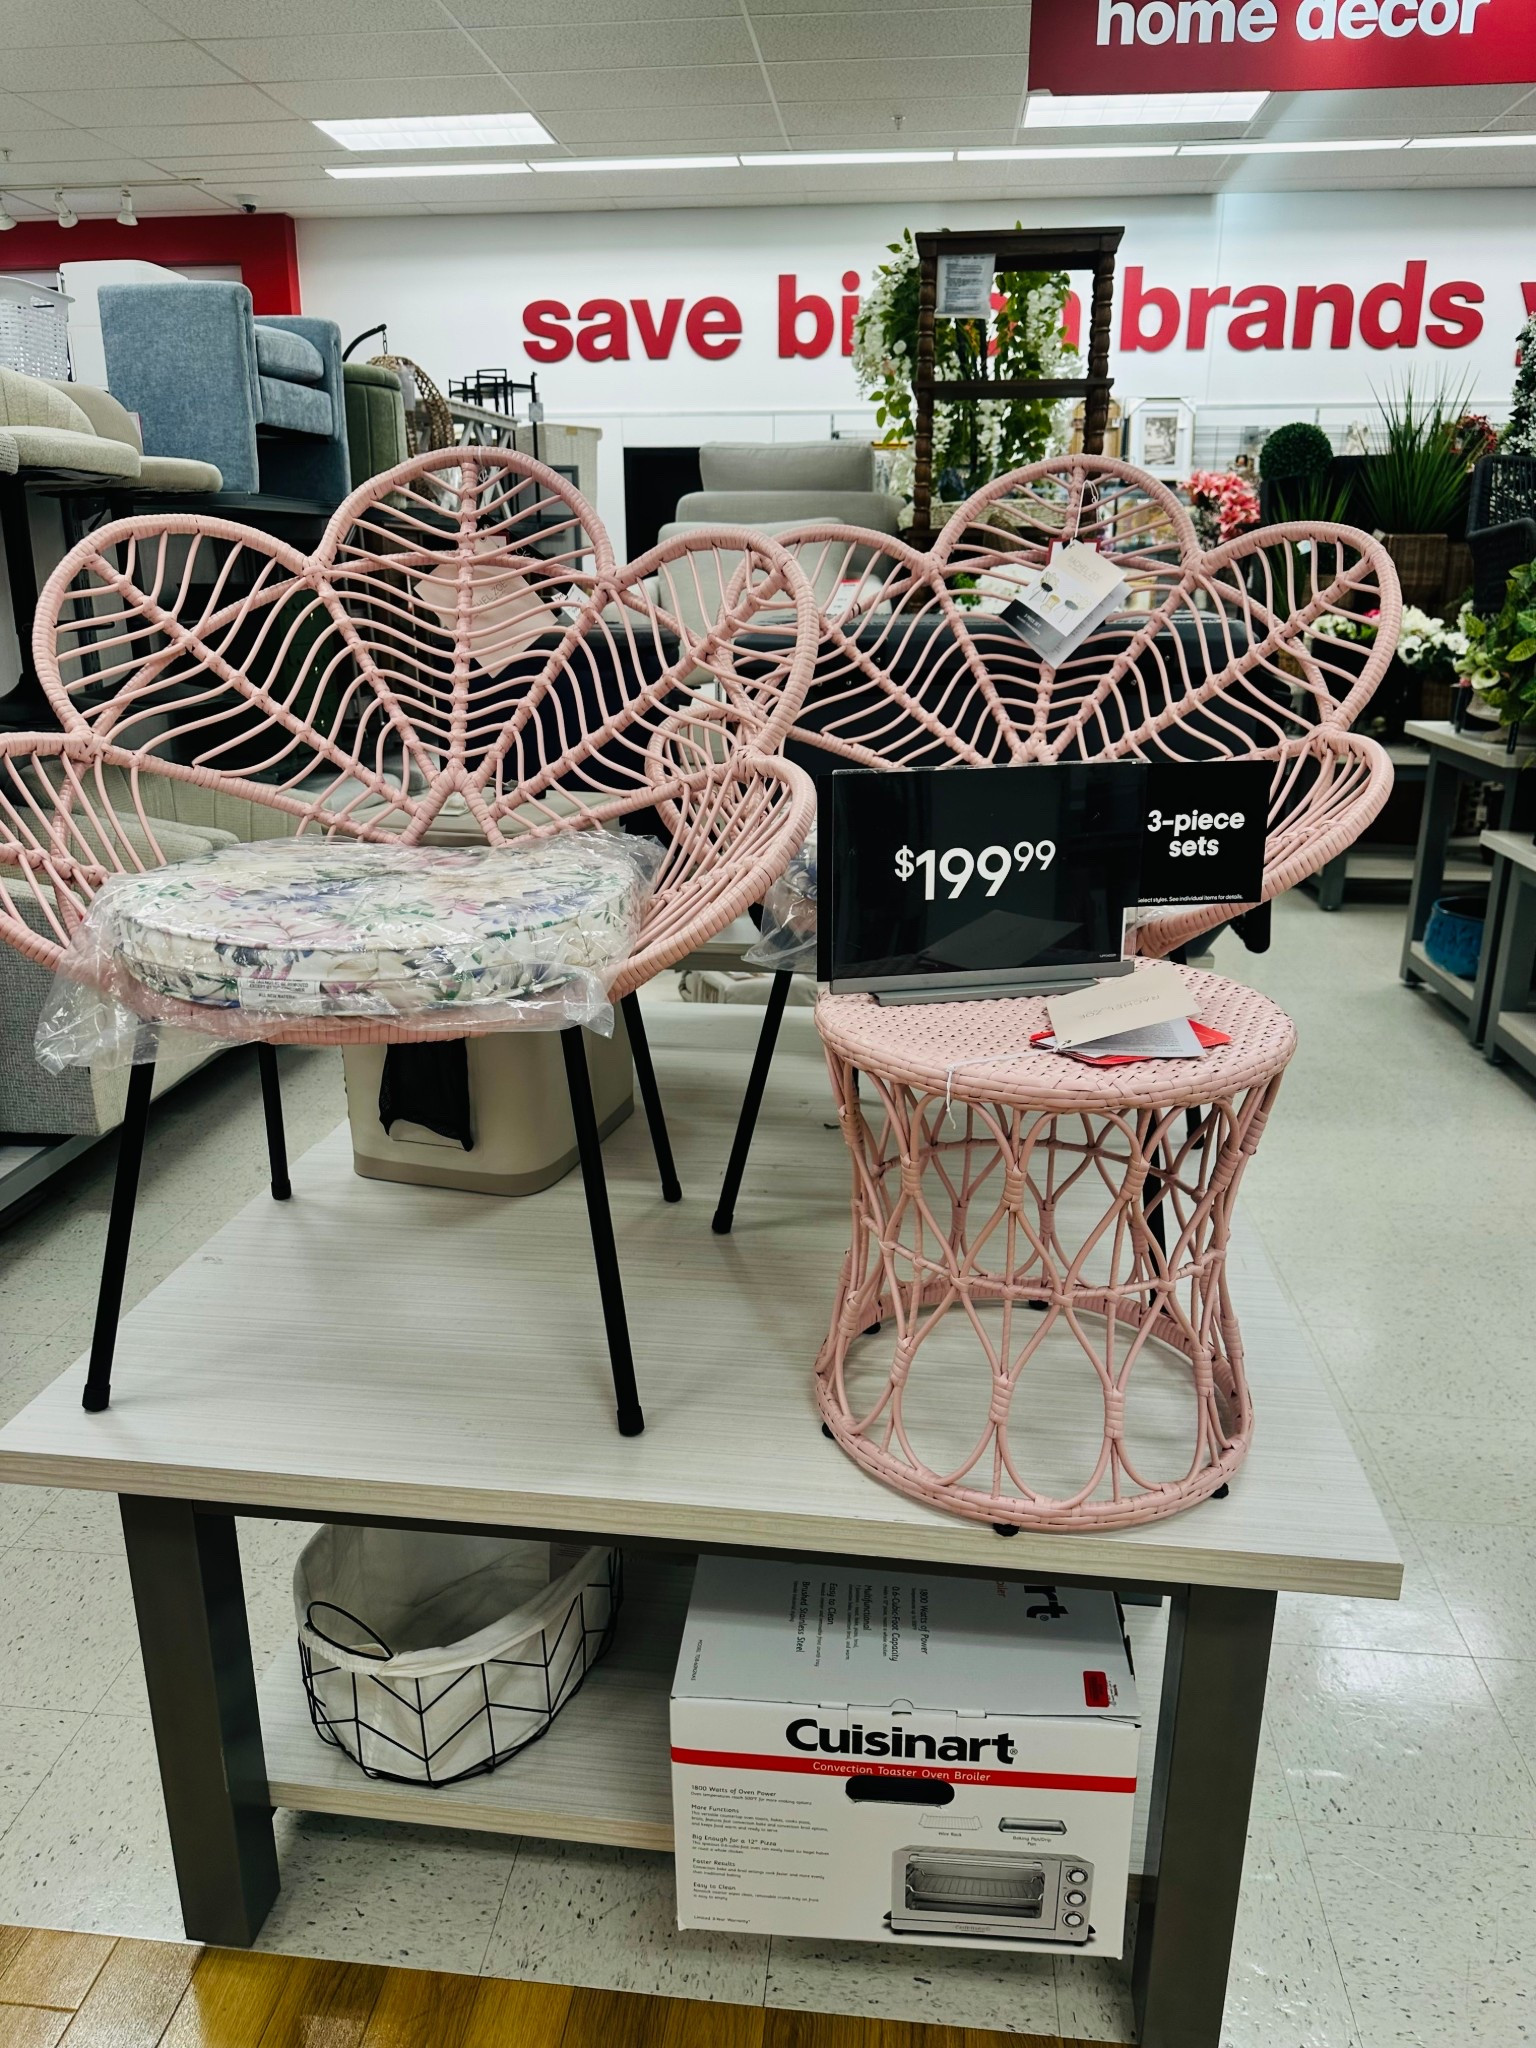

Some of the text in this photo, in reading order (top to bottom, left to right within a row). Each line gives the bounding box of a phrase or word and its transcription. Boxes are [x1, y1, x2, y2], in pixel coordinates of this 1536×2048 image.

[1096, 0, 1277, 46] home
[522, 295, 743, 362] save
[777, 270, 861, 359] bi
[1120, 260, 1486, 352] brands
[1147, 809, 1245, 837] 3-piece
[1169, 836, 1219, 857] sets
[827, 1583, 838, 1597] Easy
[796, 1582, 810, 1653] Brushed Stainless Steel
[828, 1607, 836, 1625] Clean
[861, 1584, 872, 1630] Multifunctional
[920, 1606, 928, 1623] Watts
[889, 1633, 900, 1661] Capacity
[920, 1634, 929, 1654] Power
[813, 1761, 991, 1782] Convection Toaster Oven Broiler
[693, 1882, 707, 1890] Easy
